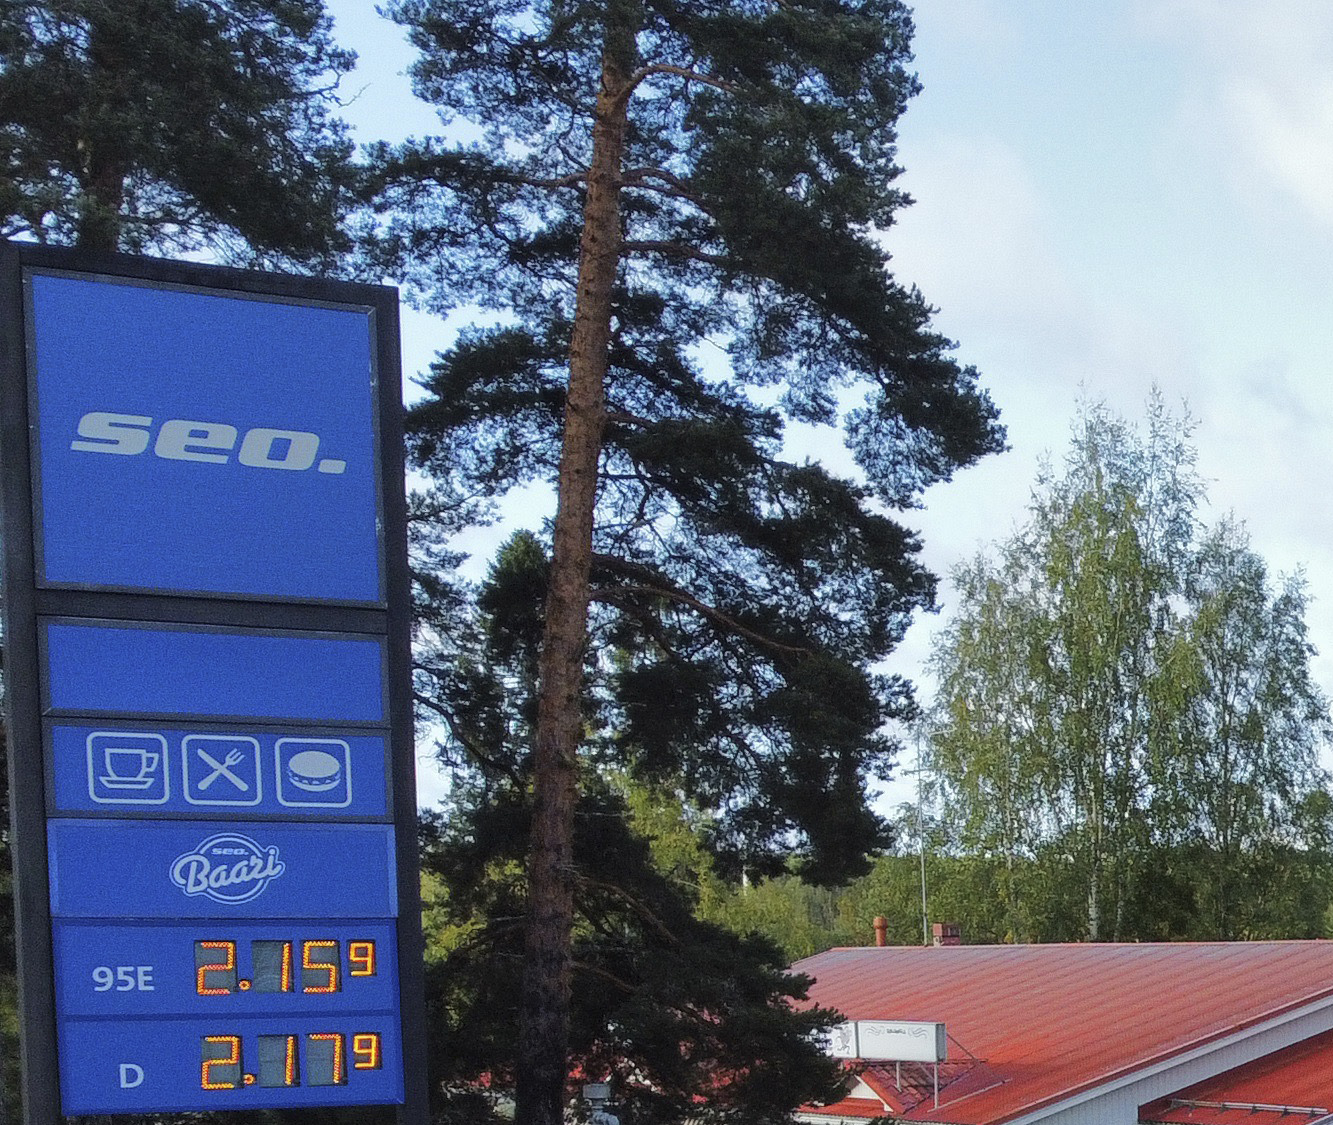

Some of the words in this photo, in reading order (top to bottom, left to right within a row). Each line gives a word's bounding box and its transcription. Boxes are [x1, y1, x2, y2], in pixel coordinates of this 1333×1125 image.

[173, 848, 282, 893] Baari
[92, 966, 155, 992] 95E
[118, 1063, 144, 1088] D
